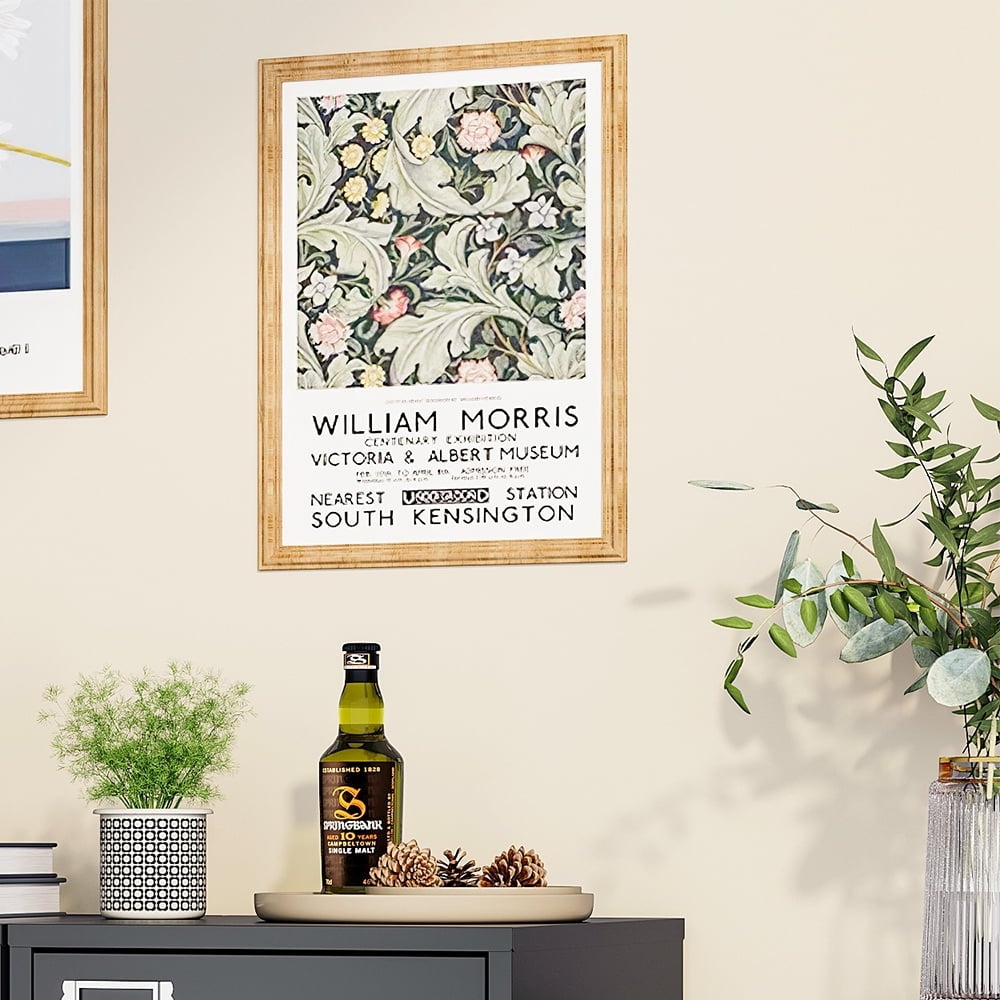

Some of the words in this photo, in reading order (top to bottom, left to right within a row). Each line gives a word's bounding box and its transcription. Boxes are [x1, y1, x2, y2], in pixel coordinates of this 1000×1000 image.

[313, 411, 437, 436] WILLIAM
[461, 405, 579, 430] MORRIS
[311, 451, 394, 466] VICTORIA
[404, 450, 415, 464] &
[428, 448, 493, 463] ALBERT
[500, 445, 580, 460] MUSEUM
[311, 491, 385, 506] NEAREST
[506, 486, 578, 500] STATION
[312, 510, 394, 528] SOUTH
[413, 504, 574, 525] KENSINGTON
[340, 832, 356, 841] 10
